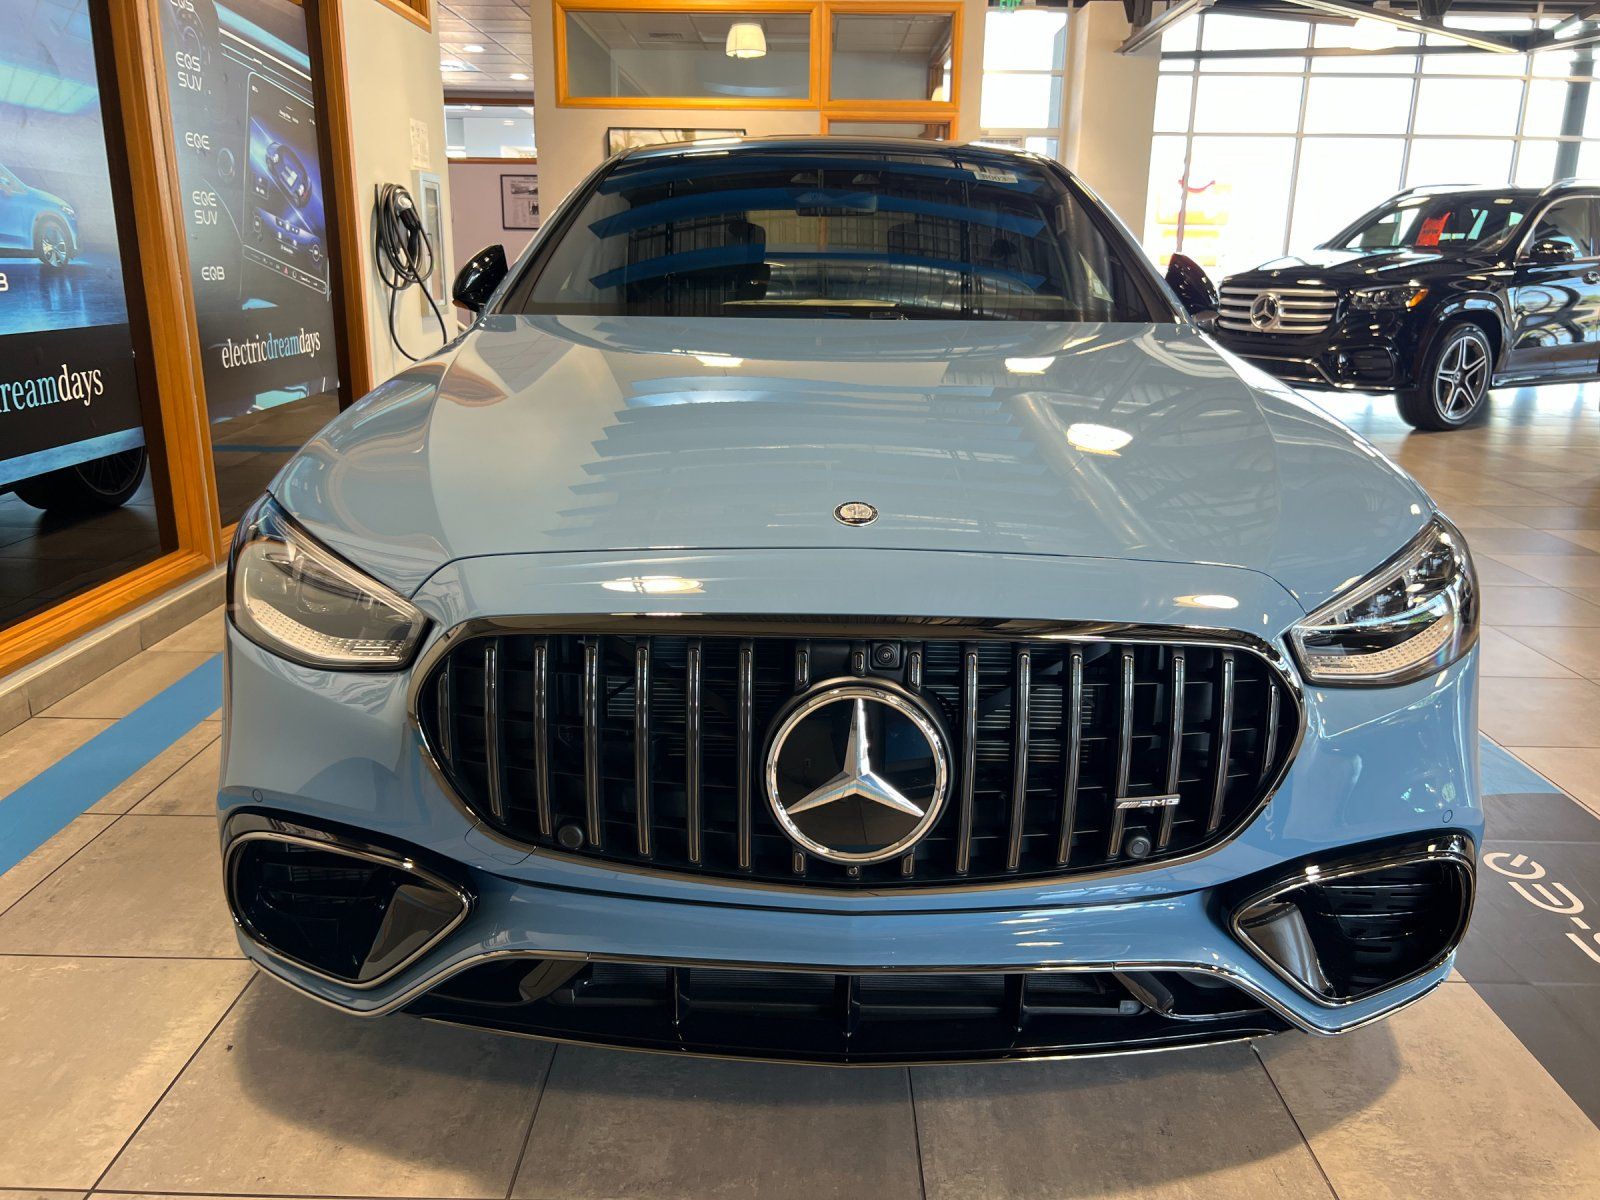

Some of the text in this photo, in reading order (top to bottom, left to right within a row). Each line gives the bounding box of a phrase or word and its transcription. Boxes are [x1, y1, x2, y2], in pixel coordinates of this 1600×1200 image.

[175, 51, 201, 72] EQS
[177, 71, 202, 91] SUV
[185, 132, 210, 150] EQE
[192, 191, 217, 206] EQE
[194, 210, 217, 225] SUV
[201, 266, 225, 280] EQB
[221, 327, 321, 369] electricdreamdays
[0, 364, 104, 413] reamdays
[1136, 797, 1180, 808] AMG
